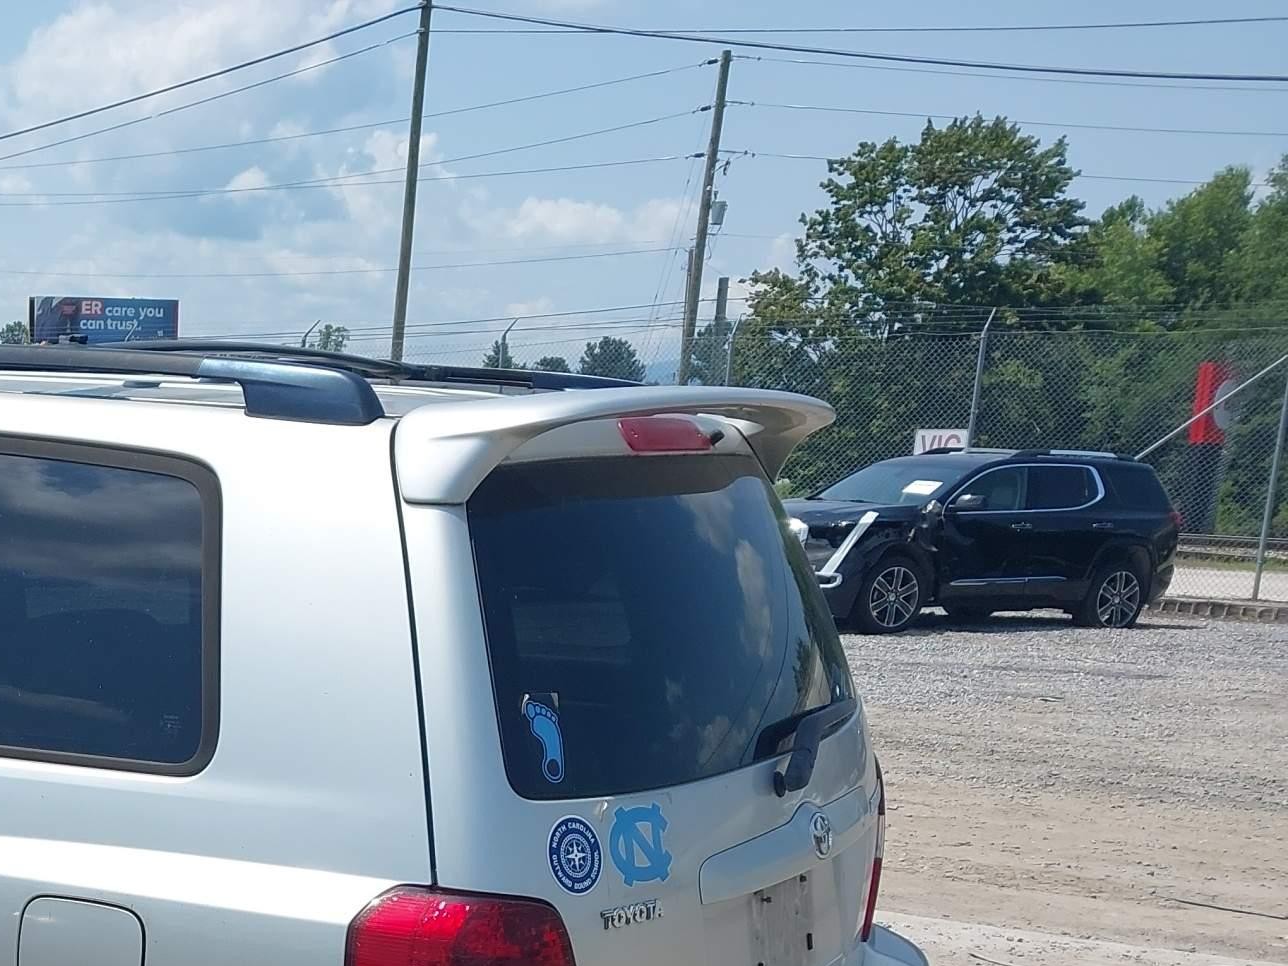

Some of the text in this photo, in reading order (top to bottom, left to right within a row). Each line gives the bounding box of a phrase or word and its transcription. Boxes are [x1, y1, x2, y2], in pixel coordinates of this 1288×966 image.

[81, 300, 164, 319] ER care you
[80, 319, 105, 330] can
[552, 822, 595, 848] NORTH CAROLINA
[552, 849, 599, 889] OUTWARD BOUND SCHOOL
[600, 899, 664, 930] TOYOTA
